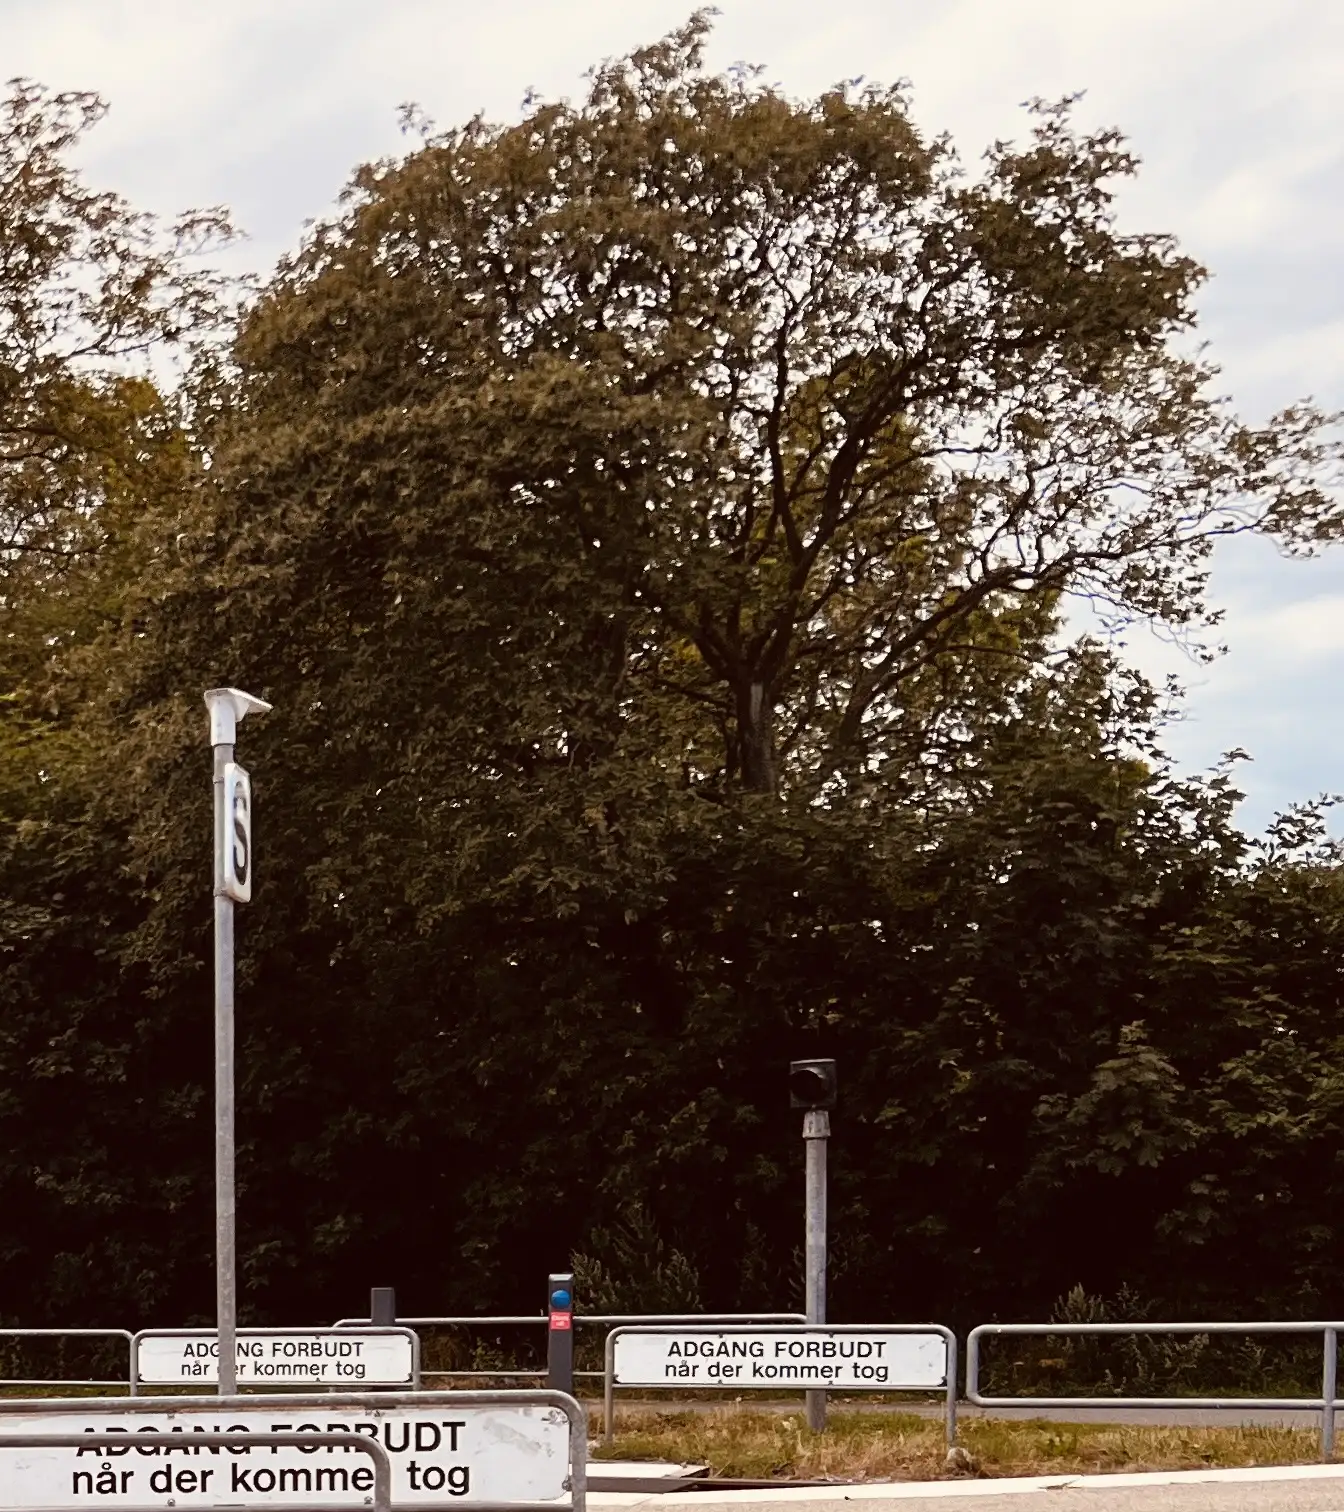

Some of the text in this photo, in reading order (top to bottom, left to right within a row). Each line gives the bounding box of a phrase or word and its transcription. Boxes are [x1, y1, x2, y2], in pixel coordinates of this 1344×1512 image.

[183, 1342, 364, 1358] ADGNG FORBUDT
[667, 1341, 887, 1358] ADGANG FORBUDT
[181, 1359, 210, 1376] når
[254, 1361, 328, 1376] kommer
[336, 1360, 366, 1379] tog
[665, 1360, 889, 1382] når der kommer tog
[72, 1460, 470, 1497] når der komme tog
